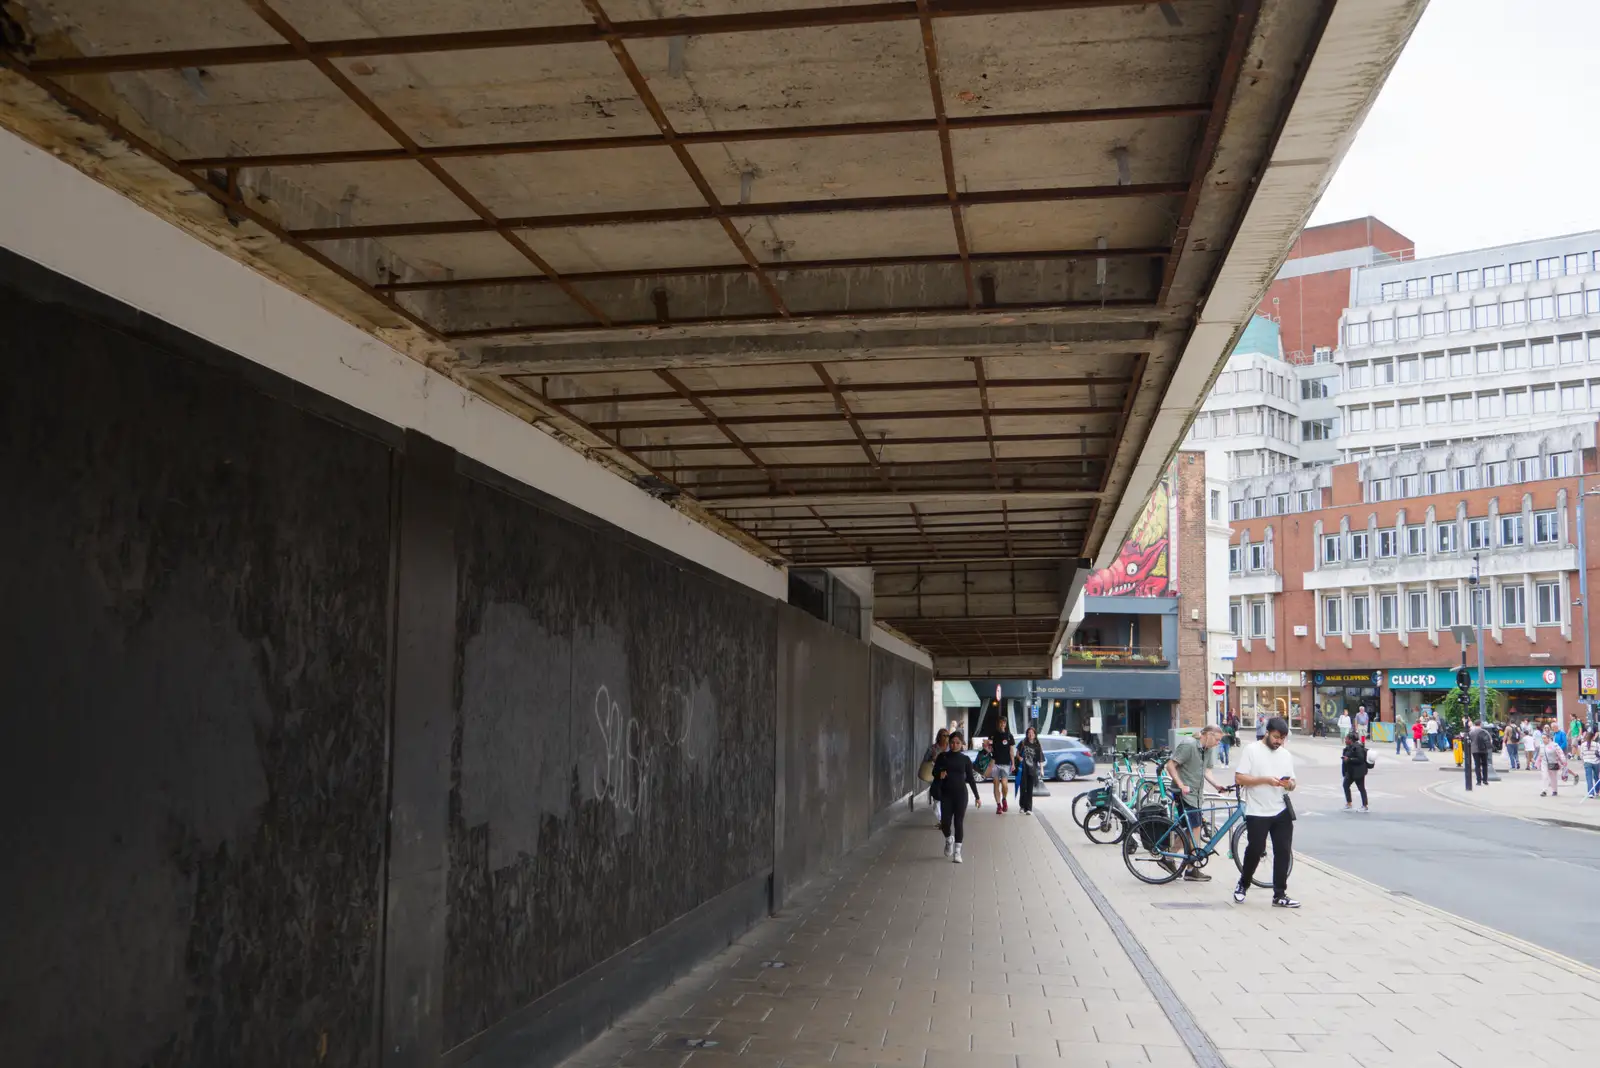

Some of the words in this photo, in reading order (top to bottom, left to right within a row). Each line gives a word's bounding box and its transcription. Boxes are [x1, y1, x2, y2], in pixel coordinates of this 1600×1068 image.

[1243, 672, 1258, 682] The
[1259, 672, 1274, 682] Nail
[1275, 672, 1292, 685] City
